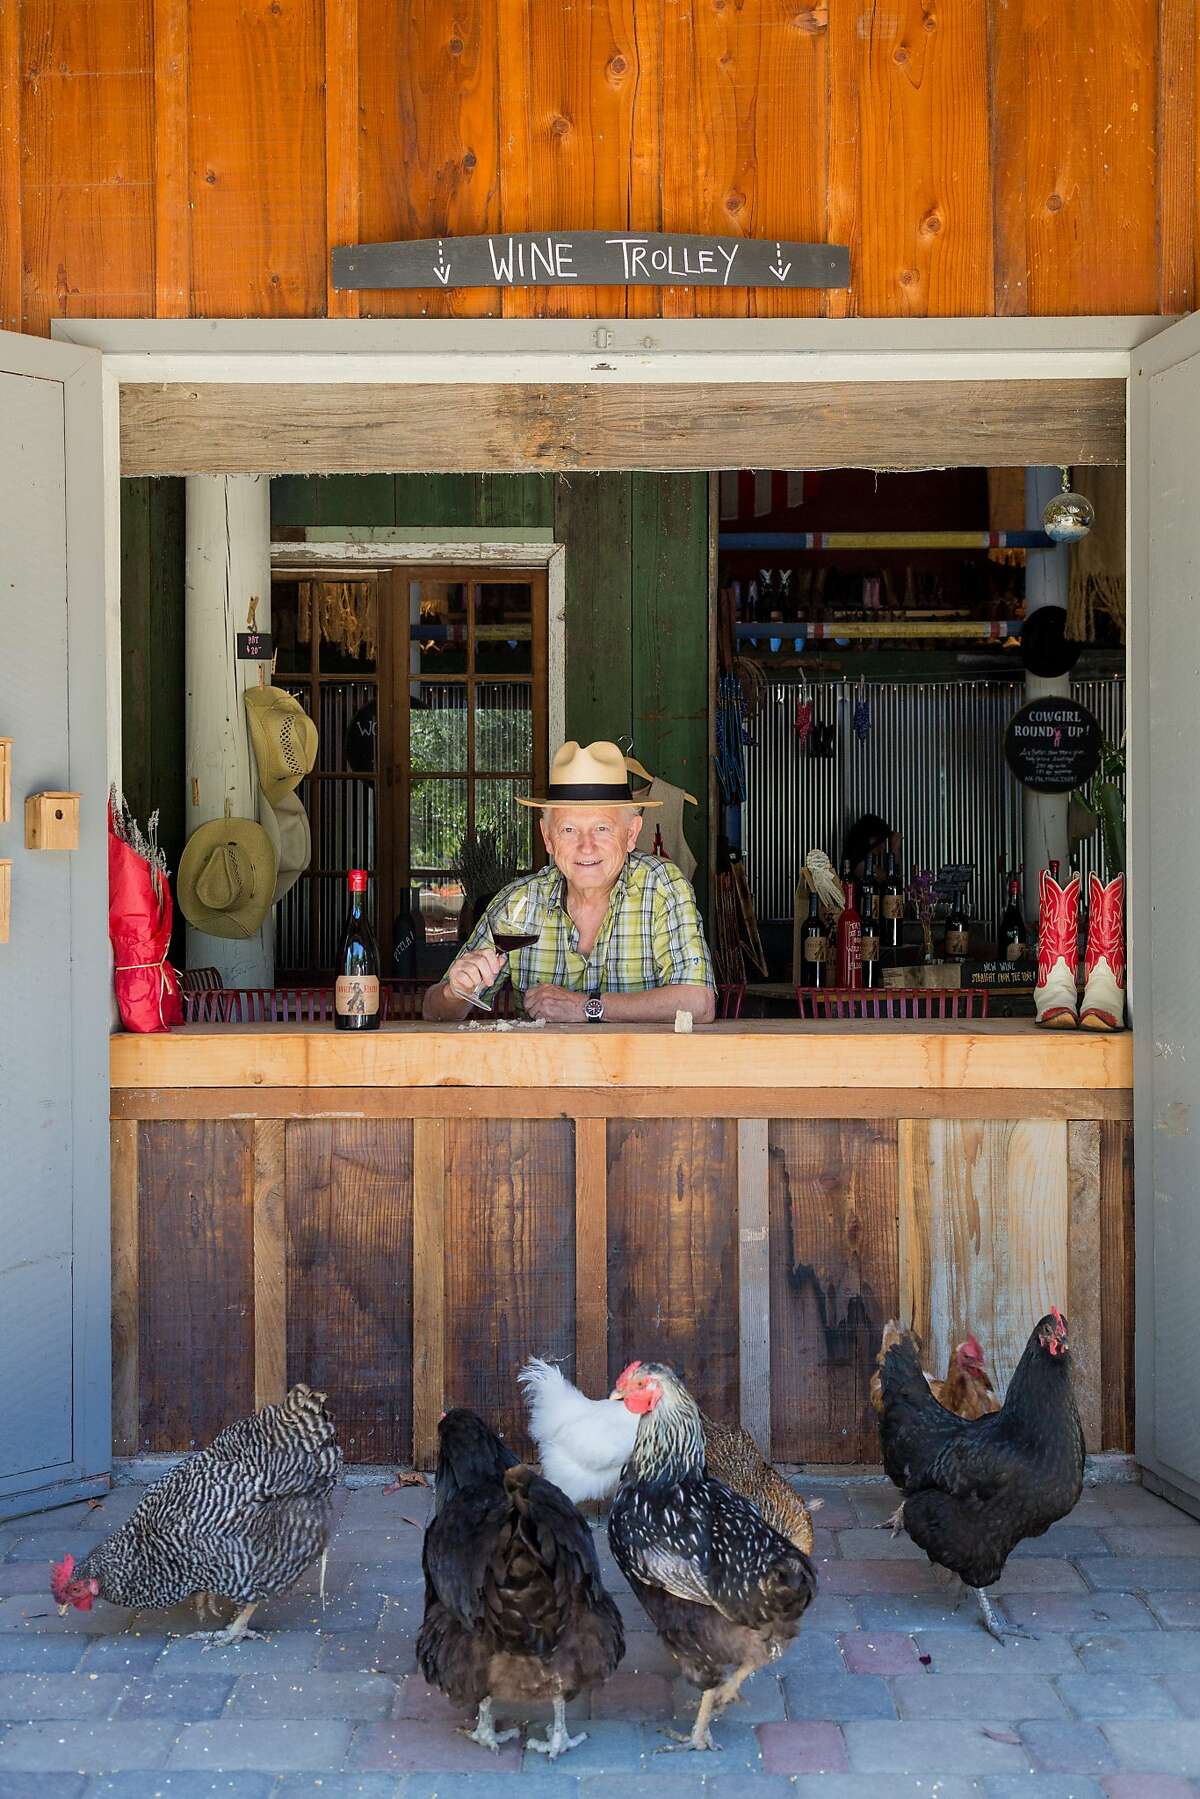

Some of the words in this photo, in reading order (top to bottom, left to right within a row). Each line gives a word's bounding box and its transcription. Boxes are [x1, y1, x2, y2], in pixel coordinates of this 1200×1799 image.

[488, 238, 578, 282] WINE
[606, 238, 739, 285] TROLLEY
[1028, 711, 1081, 722] COWGIRL
[1014, 725, 1054, 737] ROUND
